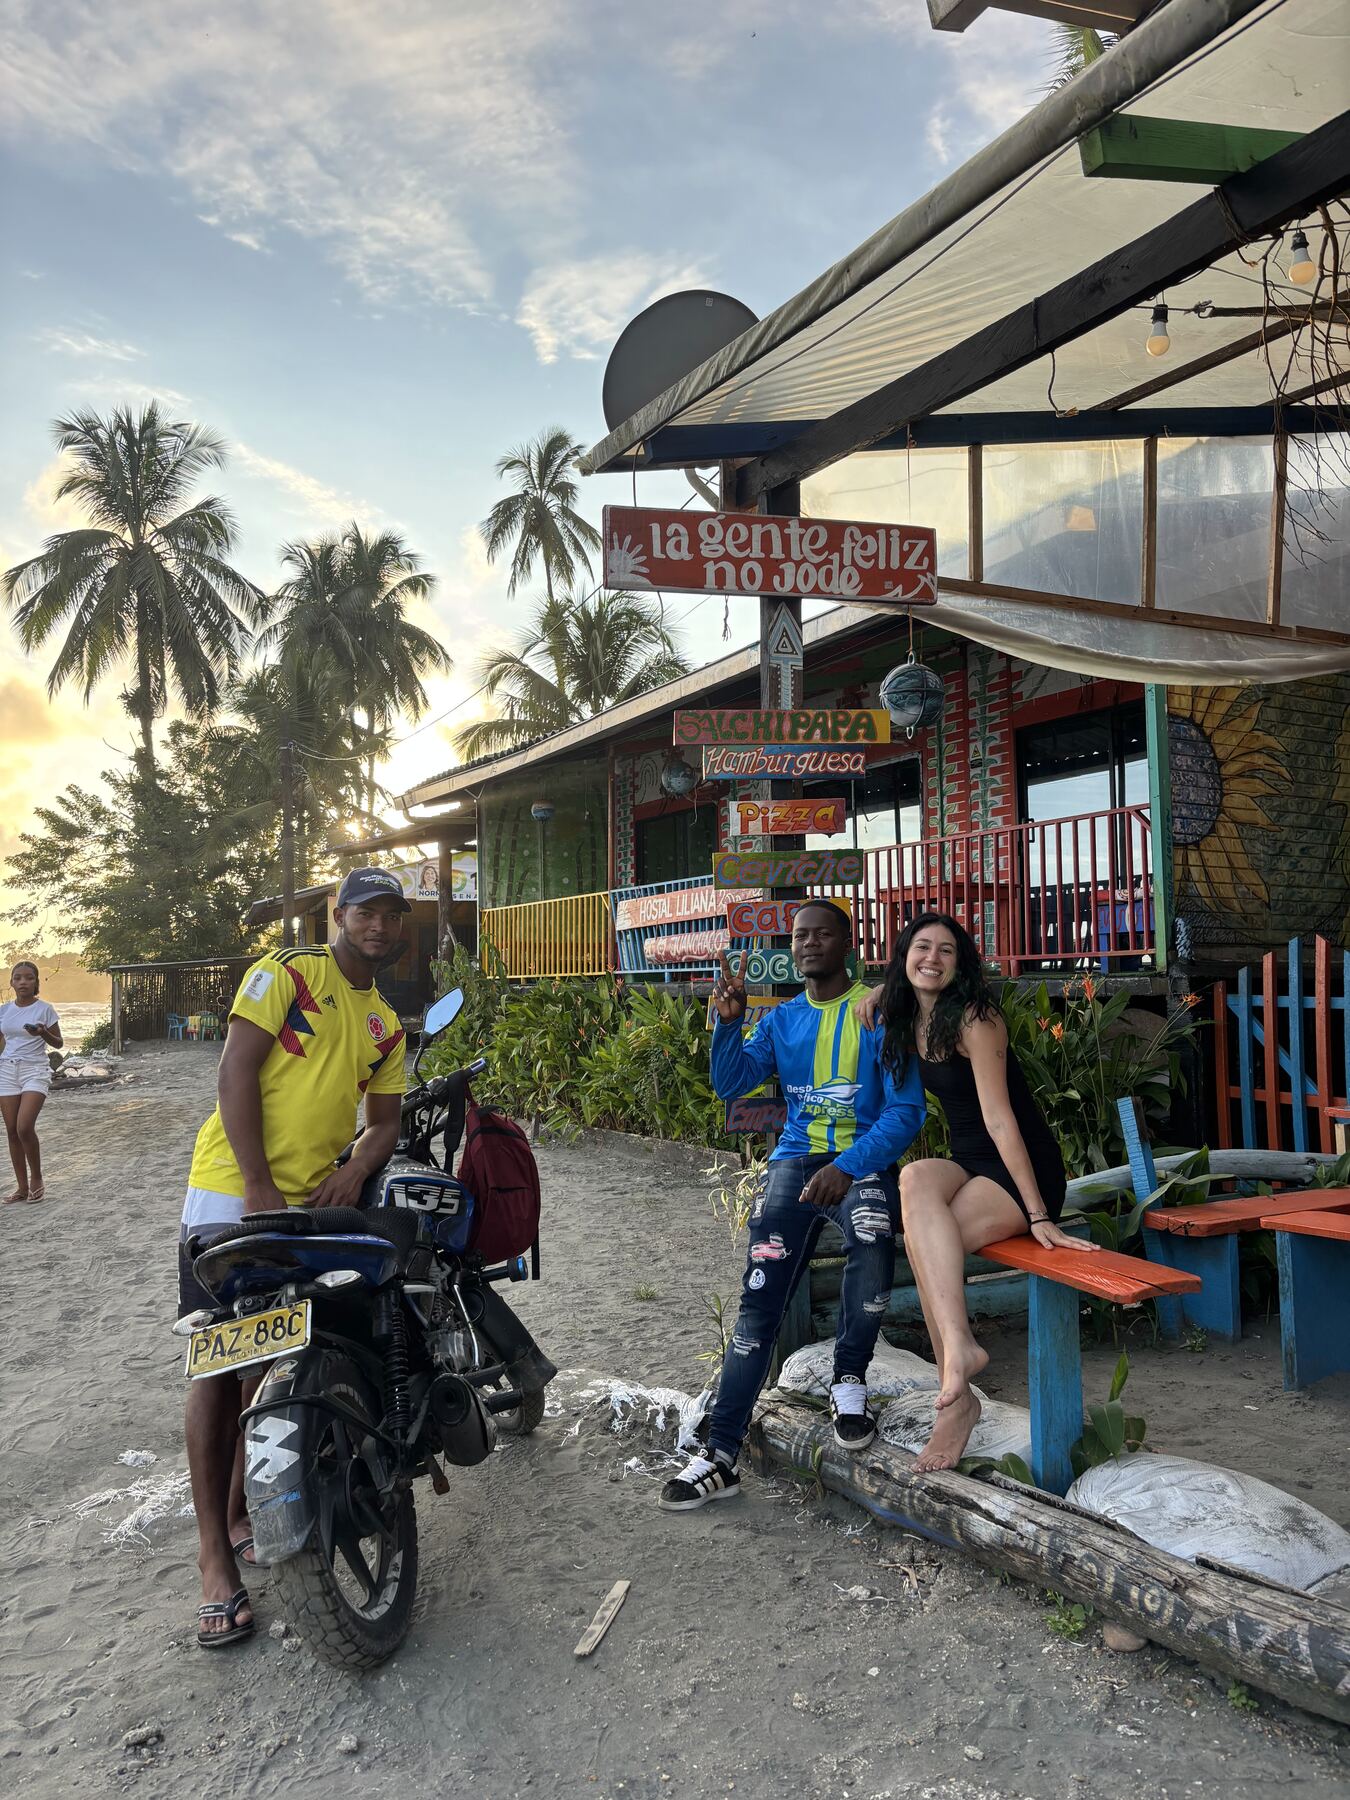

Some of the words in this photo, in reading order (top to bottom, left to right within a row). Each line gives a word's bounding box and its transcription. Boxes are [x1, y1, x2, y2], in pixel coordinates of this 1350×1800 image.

[649, 522, 694, 561] la
[698, 514, 829, 564] gente
[841, 526, 930, 570] feliz
[703, 560, 763, 591] no
[678, 711, 878, 742] SALCHIPAPA
[706, 746, 866, 776] Hamburguesa
[737, 802, 838, 834] Pizza
[716, 851, 860, 886] Ceviche
[640, 898, 673, 923] HOSTAL
[676, 889, 717, 917] LILIANA
[389, 1183, 461, 1215] 135
